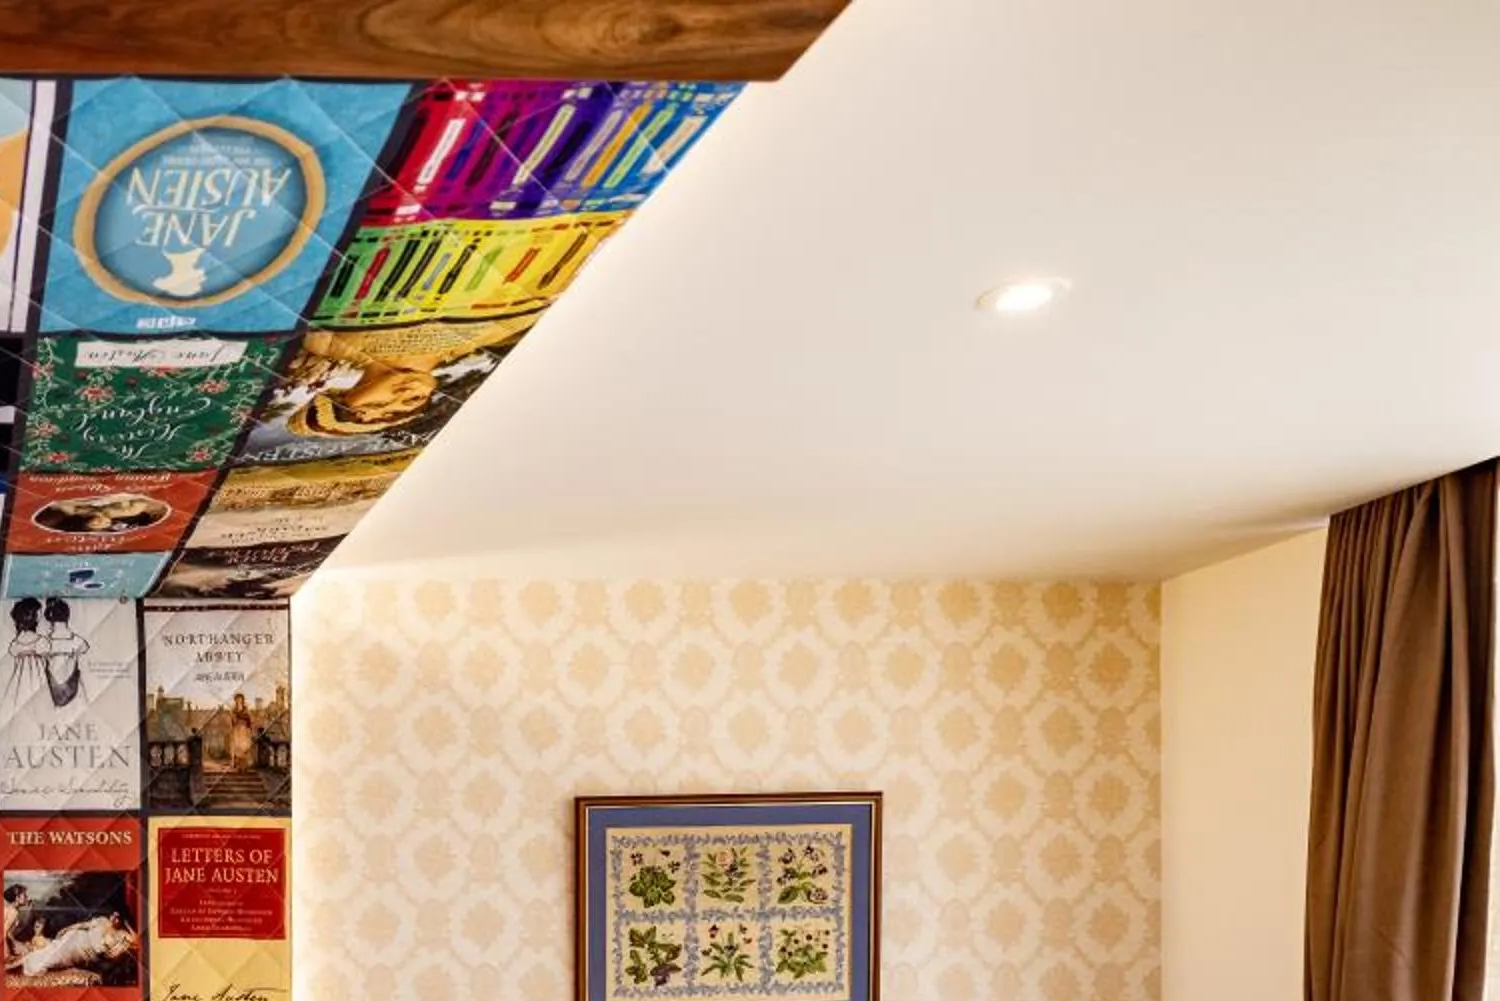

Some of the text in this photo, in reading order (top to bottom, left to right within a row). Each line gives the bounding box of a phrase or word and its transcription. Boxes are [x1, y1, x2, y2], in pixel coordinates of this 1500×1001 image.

[126, 167, 291, 213] AUSTEN
[136, 208, 256, 247] JANE
[162, 632, 275, 645] NORTHANGER
[40, 722, 98, 740] JANE
[3, 745, 131, 769] AUSTEN
[7, 831, 132, 845] THE WATSONS
[171, 848, 273, 864] LETTERS OF
[164, 867, 279, 884] JANE AUSTEN
